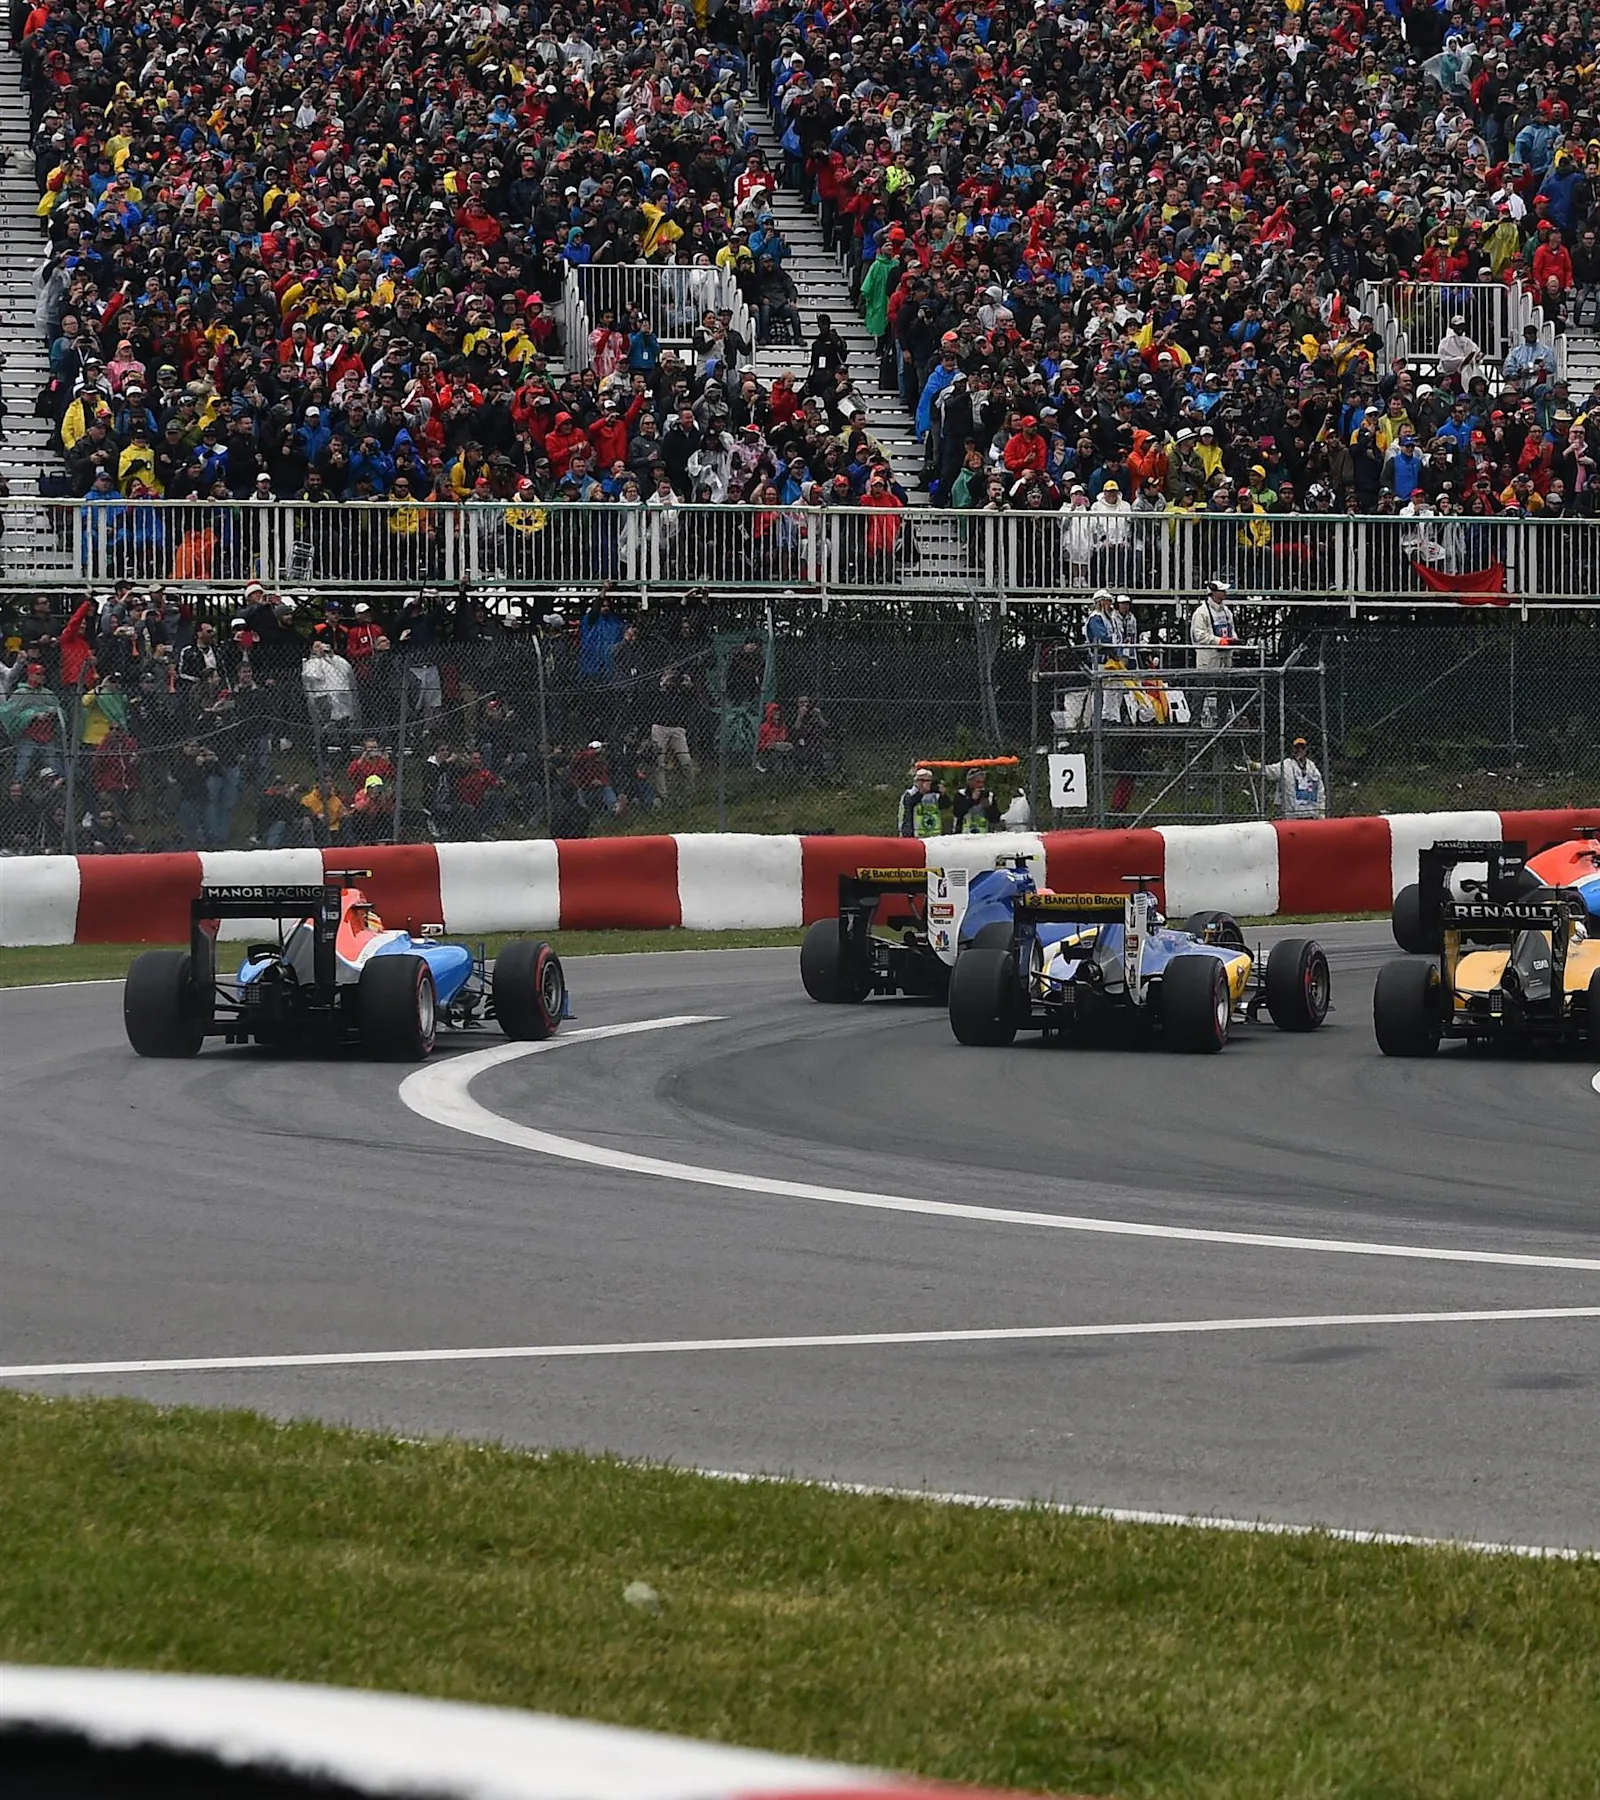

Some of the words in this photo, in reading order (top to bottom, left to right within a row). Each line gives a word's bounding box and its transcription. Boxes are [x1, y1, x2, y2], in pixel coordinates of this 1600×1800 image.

[1062, 769, 1075, 793] 2
[208, 887, 263, 898] MANOR
[266, 887, 322, 898] RACING
[1044, 895, 1077, 905] BANCO
[1077, 895, 1093, 905] DO
[1455, 905, 1553, 918] RENAULT
